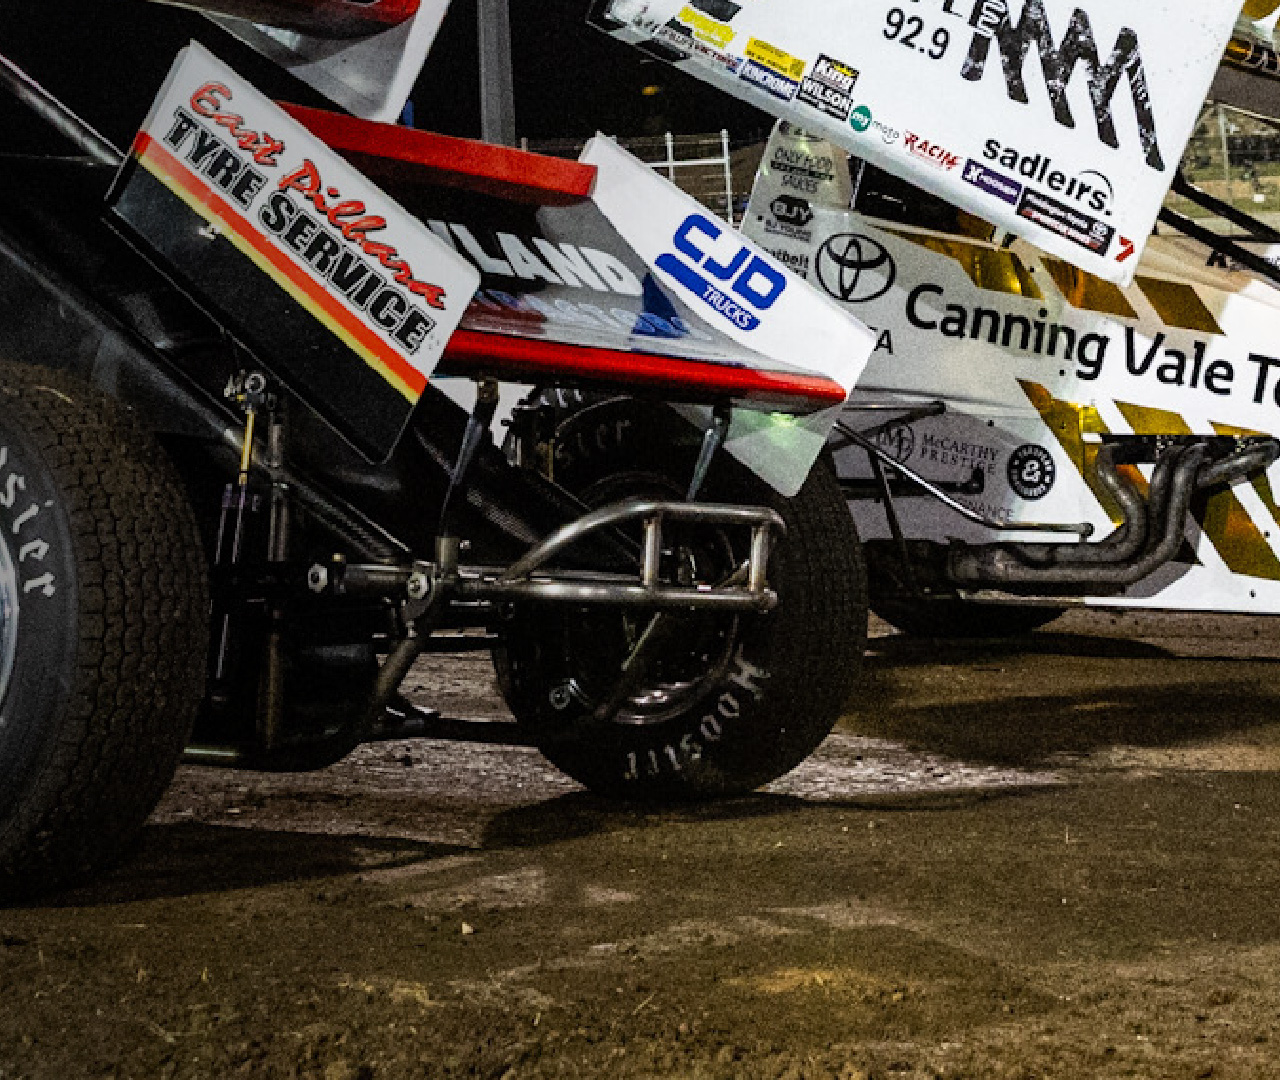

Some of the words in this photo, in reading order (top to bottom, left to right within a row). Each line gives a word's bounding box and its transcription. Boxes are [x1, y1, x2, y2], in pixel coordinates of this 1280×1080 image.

[883, 7, 950, 60] 92.9
[190, 80, 286, 168] East
[163, 105, 268, 211] TYRE
[258, 189, 437, 355] SERVICE
[279, 158, 447, 311] Pilbara
[673, 214, 787, 310] CJD
[702, 283, 751, 329] TRUCKS
[905, 284, 1109, 381] Canning
[1123, 326, 1235, 396] Vale
